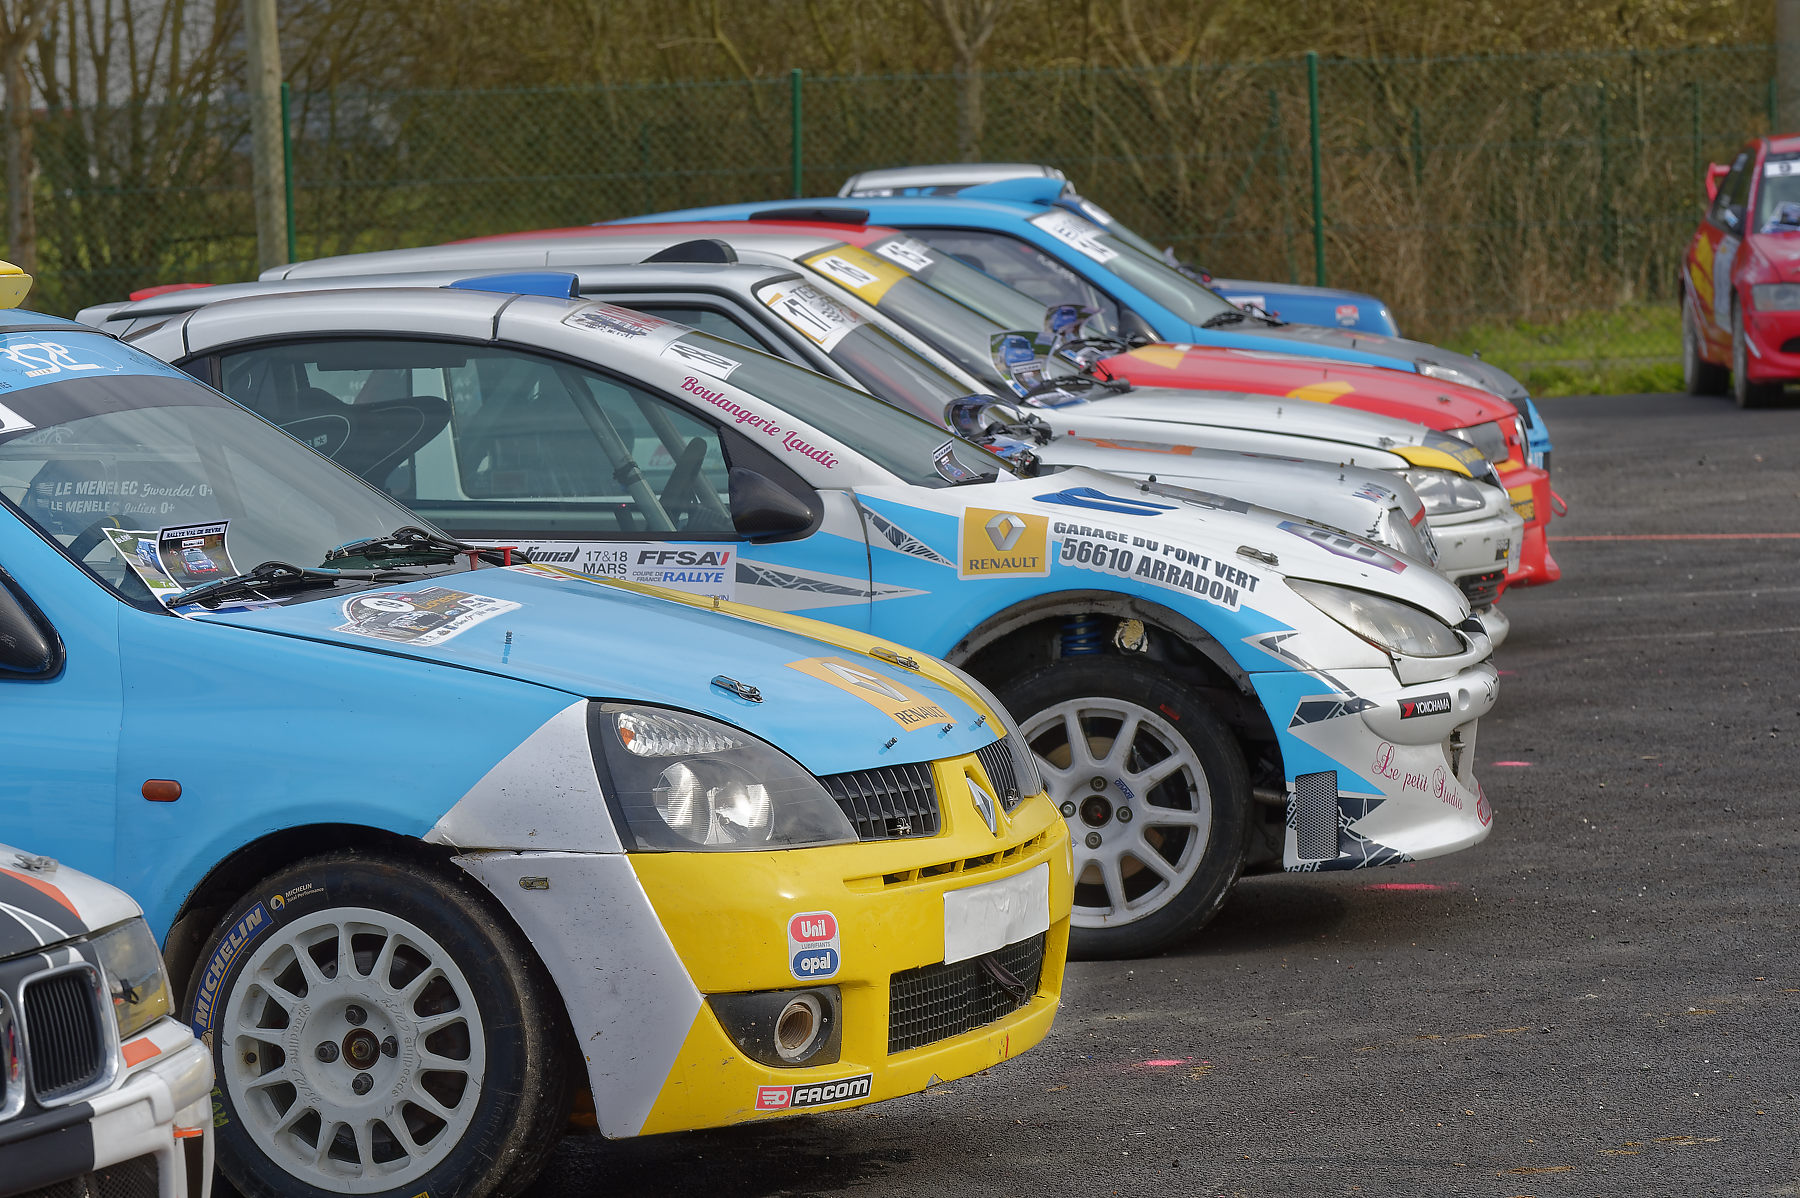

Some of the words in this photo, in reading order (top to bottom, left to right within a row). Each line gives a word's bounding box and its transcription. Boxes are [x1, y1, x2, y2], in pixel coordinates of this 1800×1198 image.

[824, 259, 871, 282] 16
[783, 299, 832, 332] 17
[681, 376, 781, 438] Boulangerie
[782, 430, 839, 469] Laudic
[54, 482, 73, 497] LE
[75, 481, 138, 497] MENELEC
[140, 484, 196, 498] Gwendal
[51, 500, 63, 511] LE
[585, 551, 628, 562] 17&18
[637, 551, 724, 566] FFSA
[969, 556, 1039, 570] RENAULT
[1053, 521, 1128, 544] GARAGE
[1132, 536, 1158, 553] DU
[1163, 543, 1213, 572] PONT
[1214, 560, 1261, 593] VERT
[583, 563, 628, 575] MARS
[662, 571, 724, 583] RALLYE
[1060, 538, 1134, 573] 56610
[1135, 555, 1240, 608] ARRADON
[893, 706, 947, 724] RENAULT
[1415, 698, 1450, 714] YOKOHAMA
[1372, 742, 1399, 780] Le
[1402, 771, 1429, 792] petit
[1432, 765, 1463, 810] Studio
[285, 883, 312, 898] MICHELIN
[801, 919, 826, 938] Unil
[801, 941, 831, 949] LUBRIFIANTS
[194, 907, 263, 1028] MICHELIN
[801, 952, 830, 974] opal
[794, 1078, 869, 1105] FACOM
